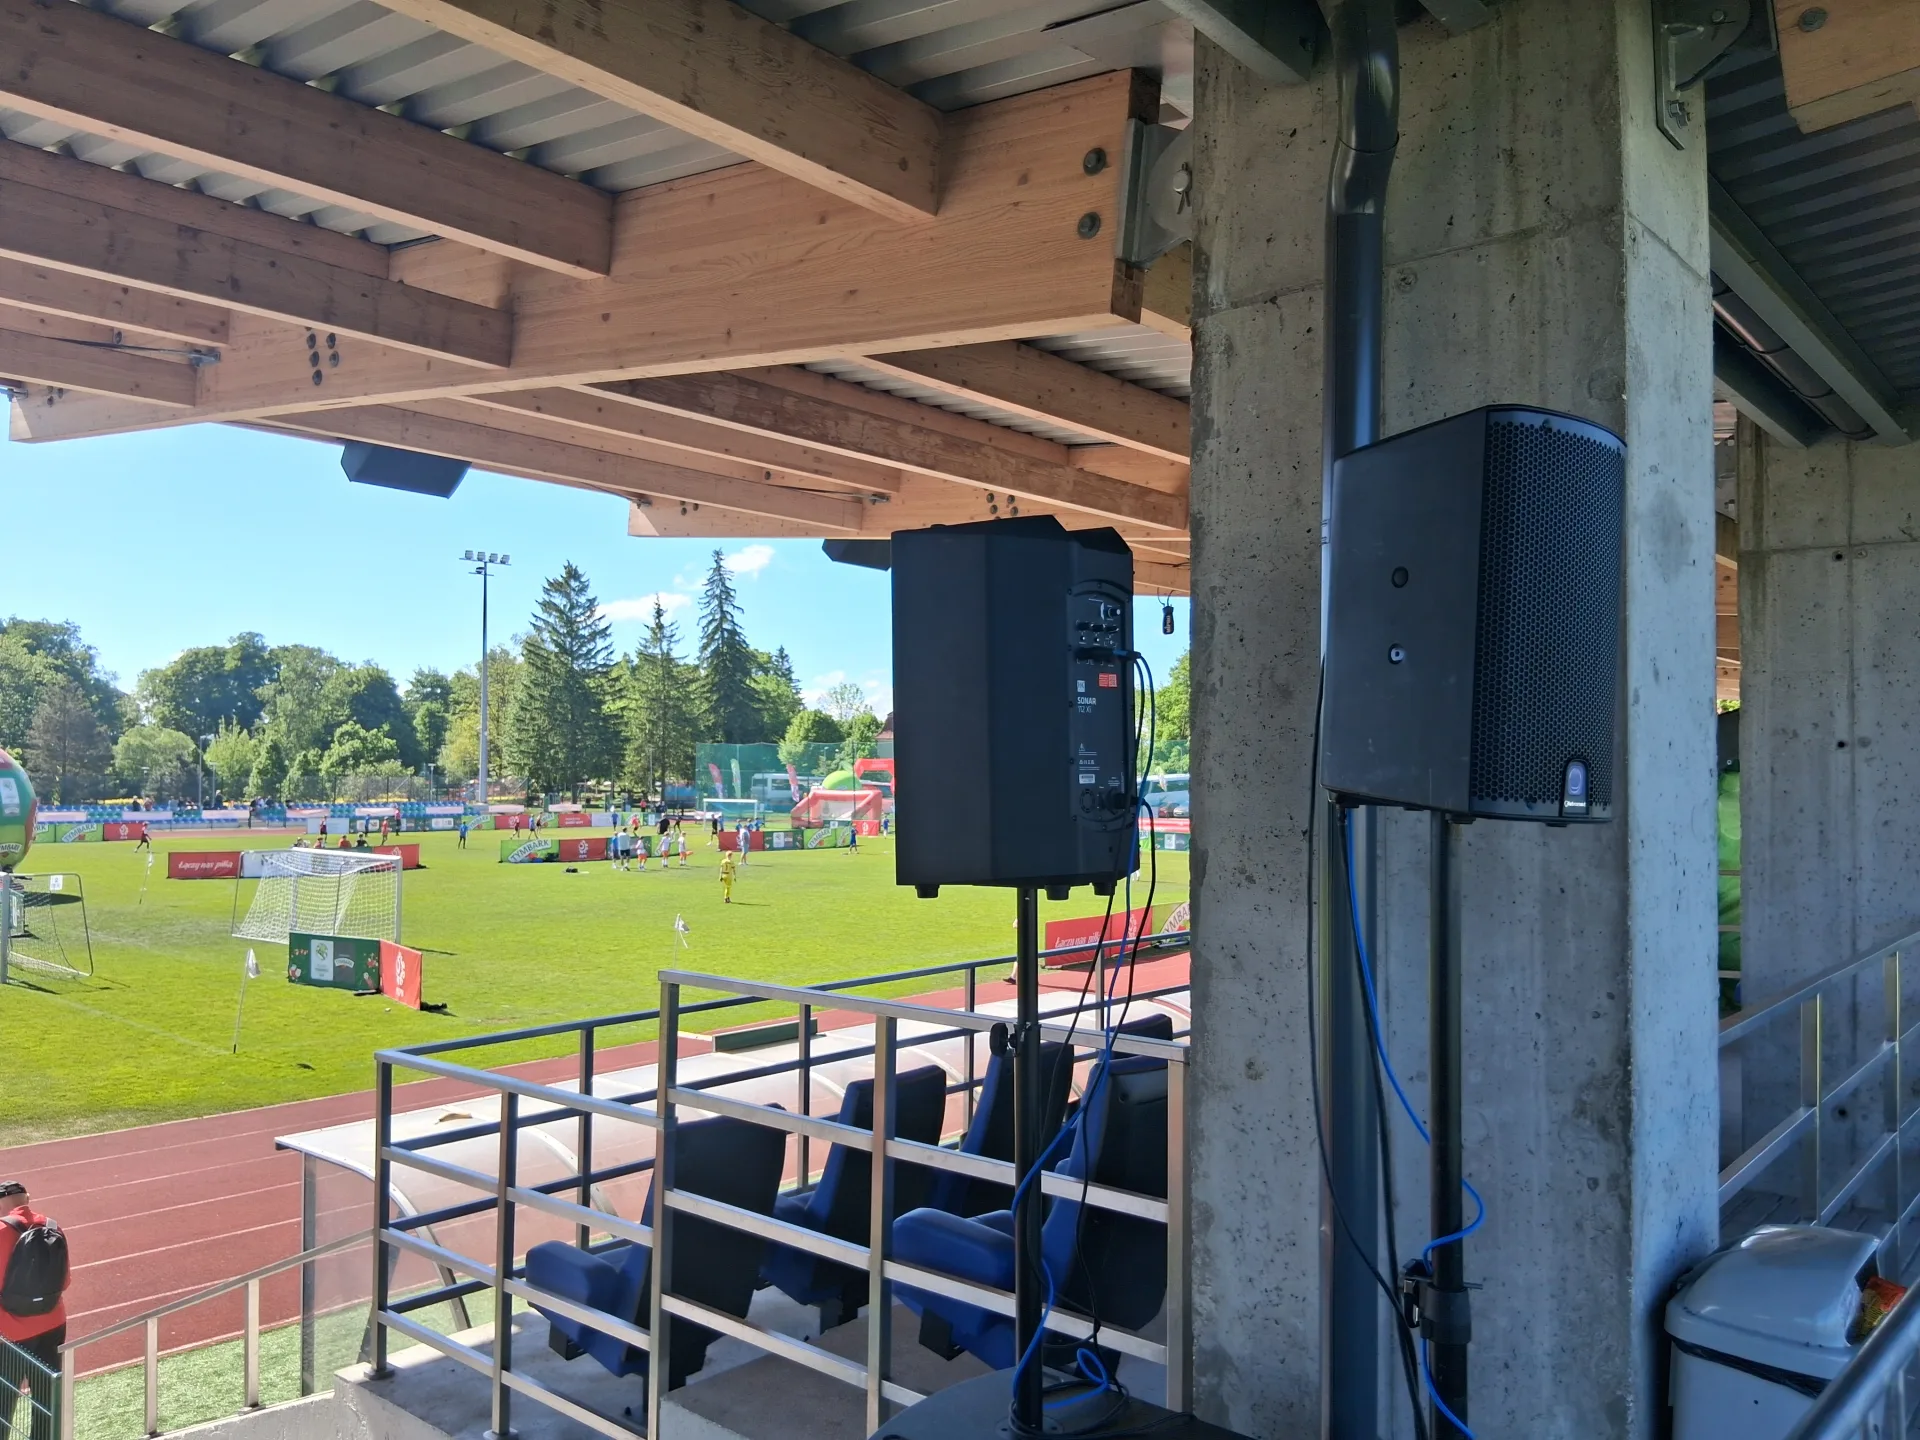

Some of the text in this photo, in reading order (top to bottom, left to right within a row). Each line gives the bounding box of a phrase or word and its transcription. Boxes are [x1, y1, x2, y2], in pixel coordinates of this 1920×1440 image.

[1077, 697, 1097, 705] SONAR
[63, 823, 97, 842] TYMBARK
[510, 839, 550, 861] TYMBARK
[1164, 906, 1189, 932] YMBA
